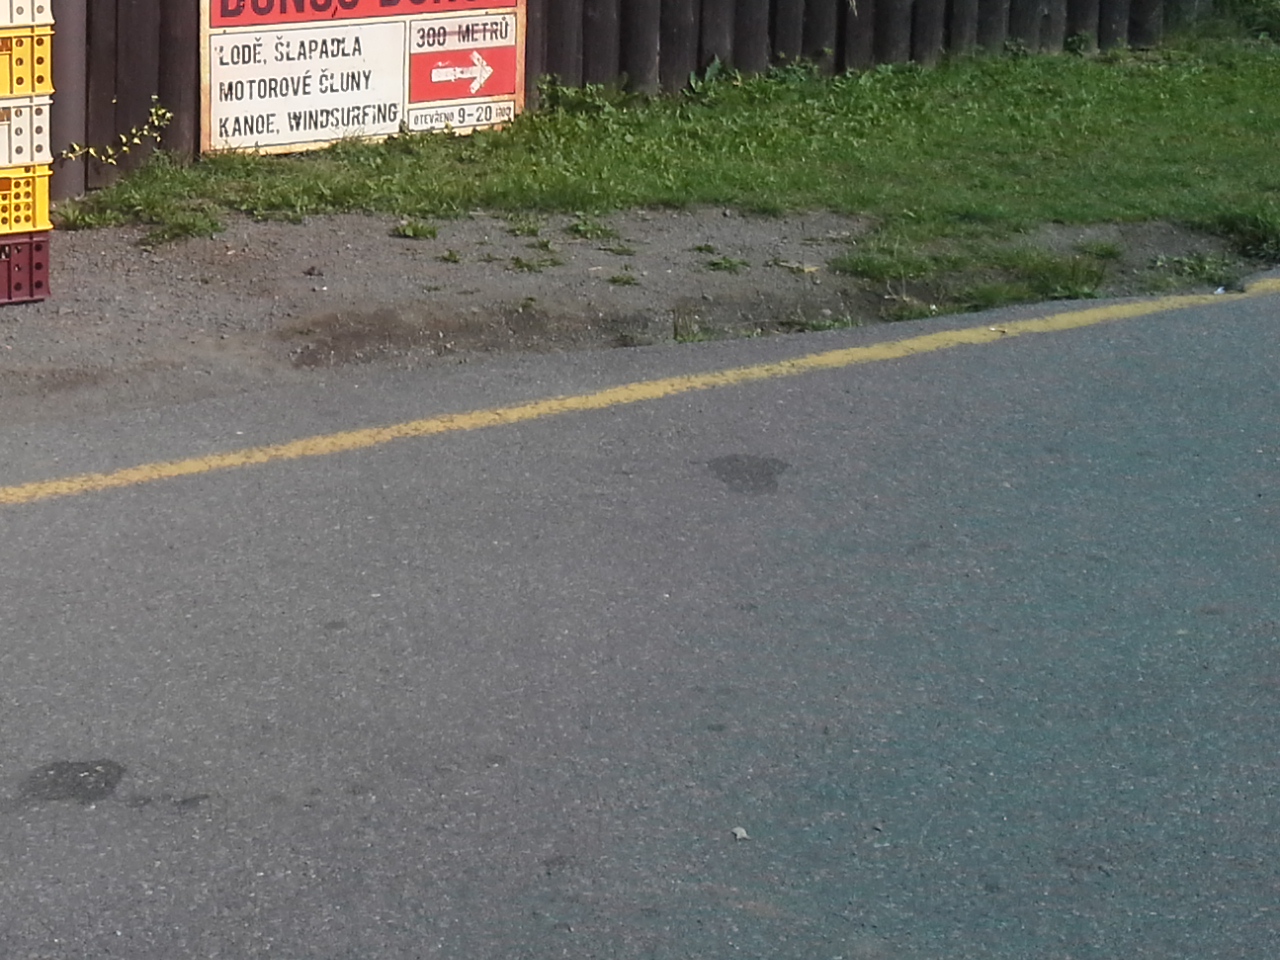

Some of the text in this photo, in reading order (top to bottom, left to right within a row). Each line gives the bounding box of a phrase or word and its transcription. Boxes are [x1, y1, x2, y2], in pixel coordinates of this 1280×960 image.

[416, 16, 509, 48] 300 METRŮ
[219, 35, 362, 66] LODĚ, ŠLAPADLA
[219, 68, 372, 102] MOTOROVÉ ČLUNY
[219, 103, 399, 138] KANOE, WINDSURFING
